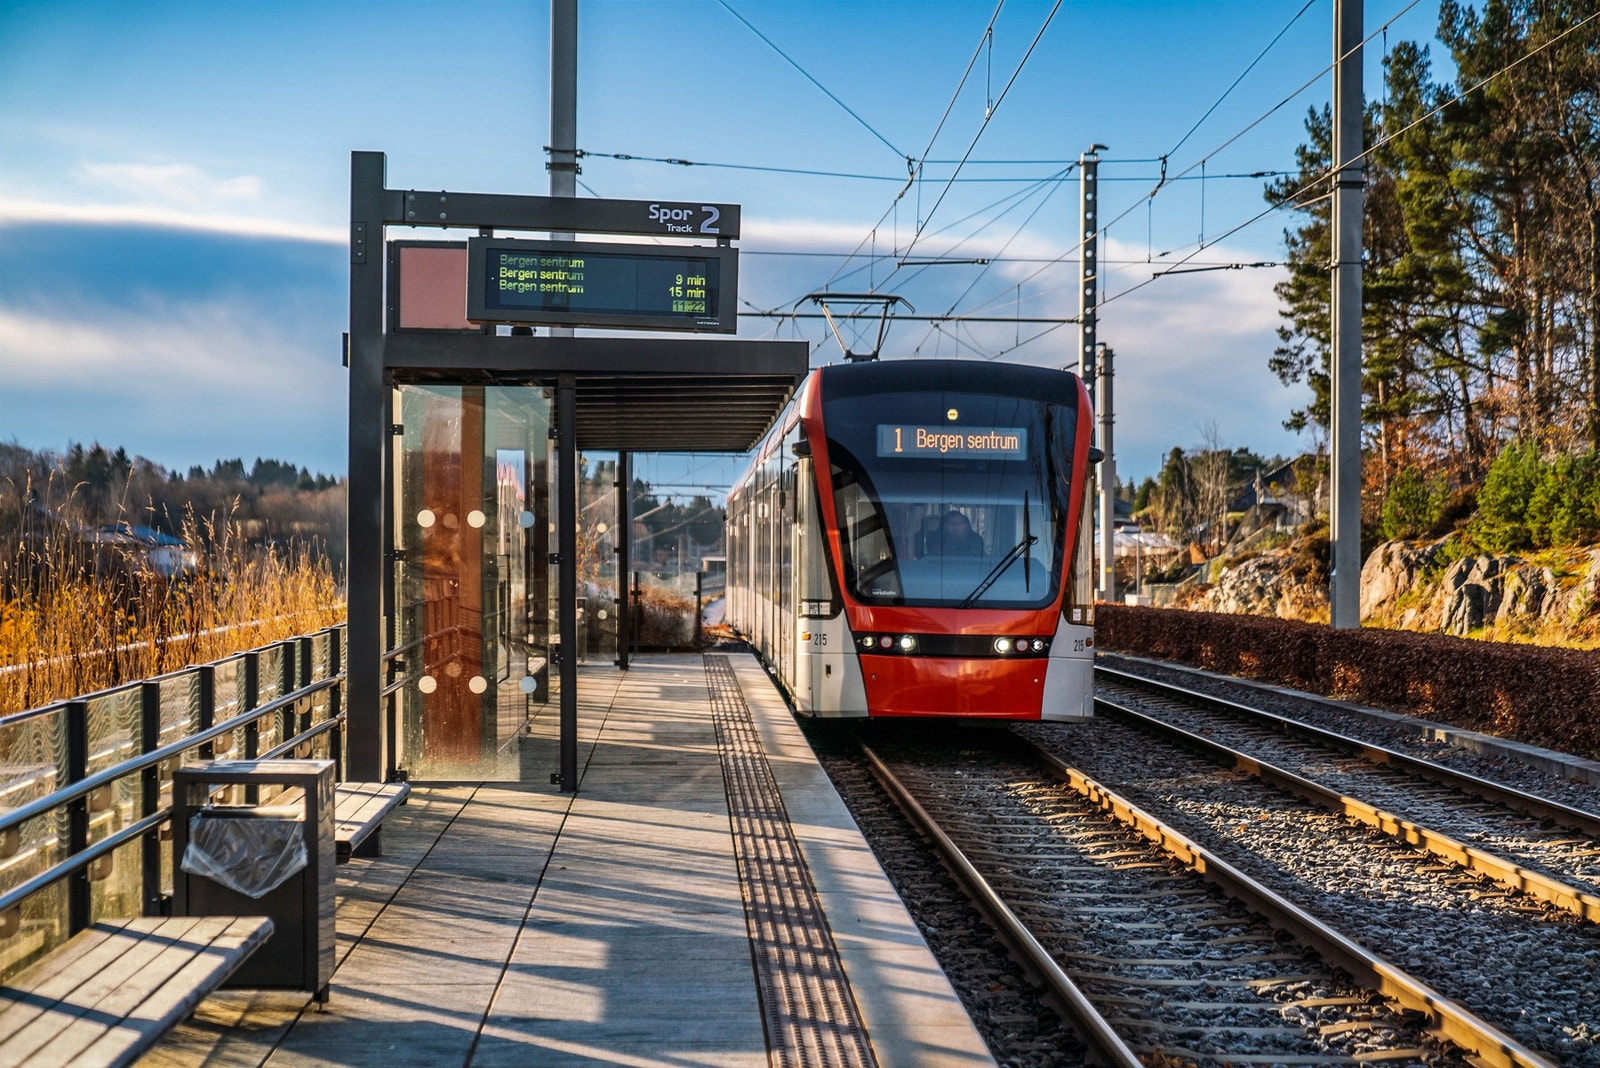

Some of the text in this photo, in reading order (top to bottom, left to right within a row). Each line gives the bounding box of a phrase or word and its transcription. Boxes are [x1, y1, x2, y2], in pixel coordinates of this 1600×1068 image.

[648, 204, 720, 234] Spor 2
[666, 223, 693, 233] Track
[500, 254, 584, 268] Bergen sentrum
[499, 267, 706, 286] Bergen sentrum 9 min
[499, 279, 705, 298] Bergen sentrum 15 min
[673, 300, 704, 312] 11:22
[894, 427, 1018, 453] 1 Bergen sentrum
[814, 633, 828, 646] 215
[1074, 640, 1084, 652] 215
